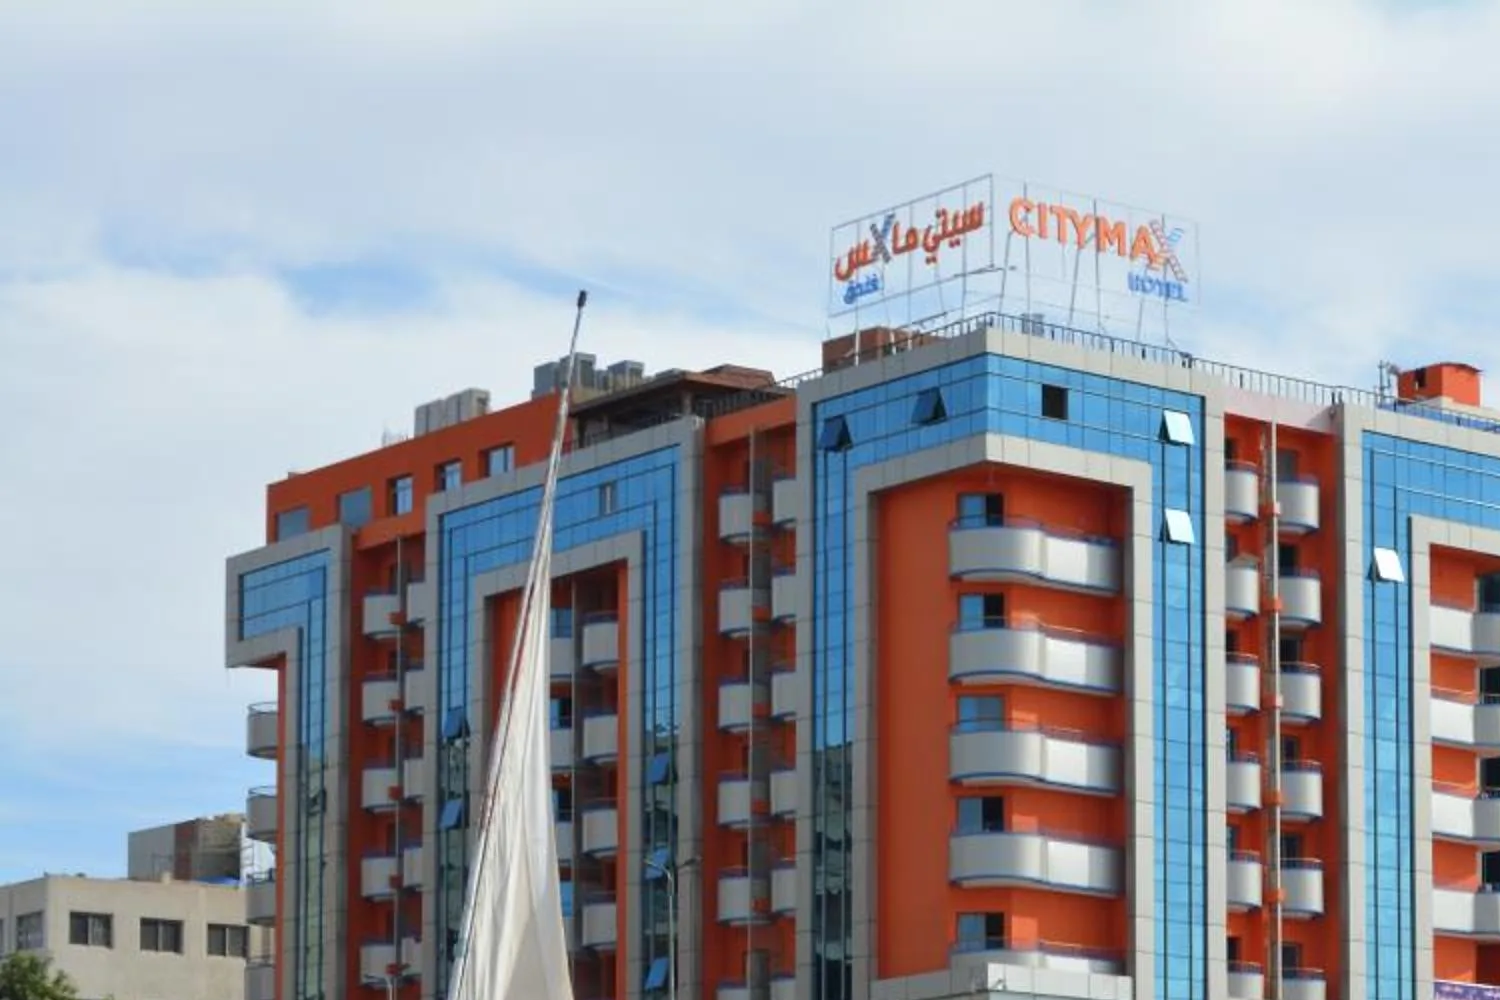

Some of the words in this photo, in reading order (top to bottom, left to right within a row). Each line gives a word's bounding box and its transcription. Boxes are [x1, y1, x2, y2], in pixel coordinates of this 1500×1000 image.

[923, 200, 985, 264] سيتي
[1009, 195, 1189, 283] CITYMAX
[1128, 271, 1189, 302] HOTEL
